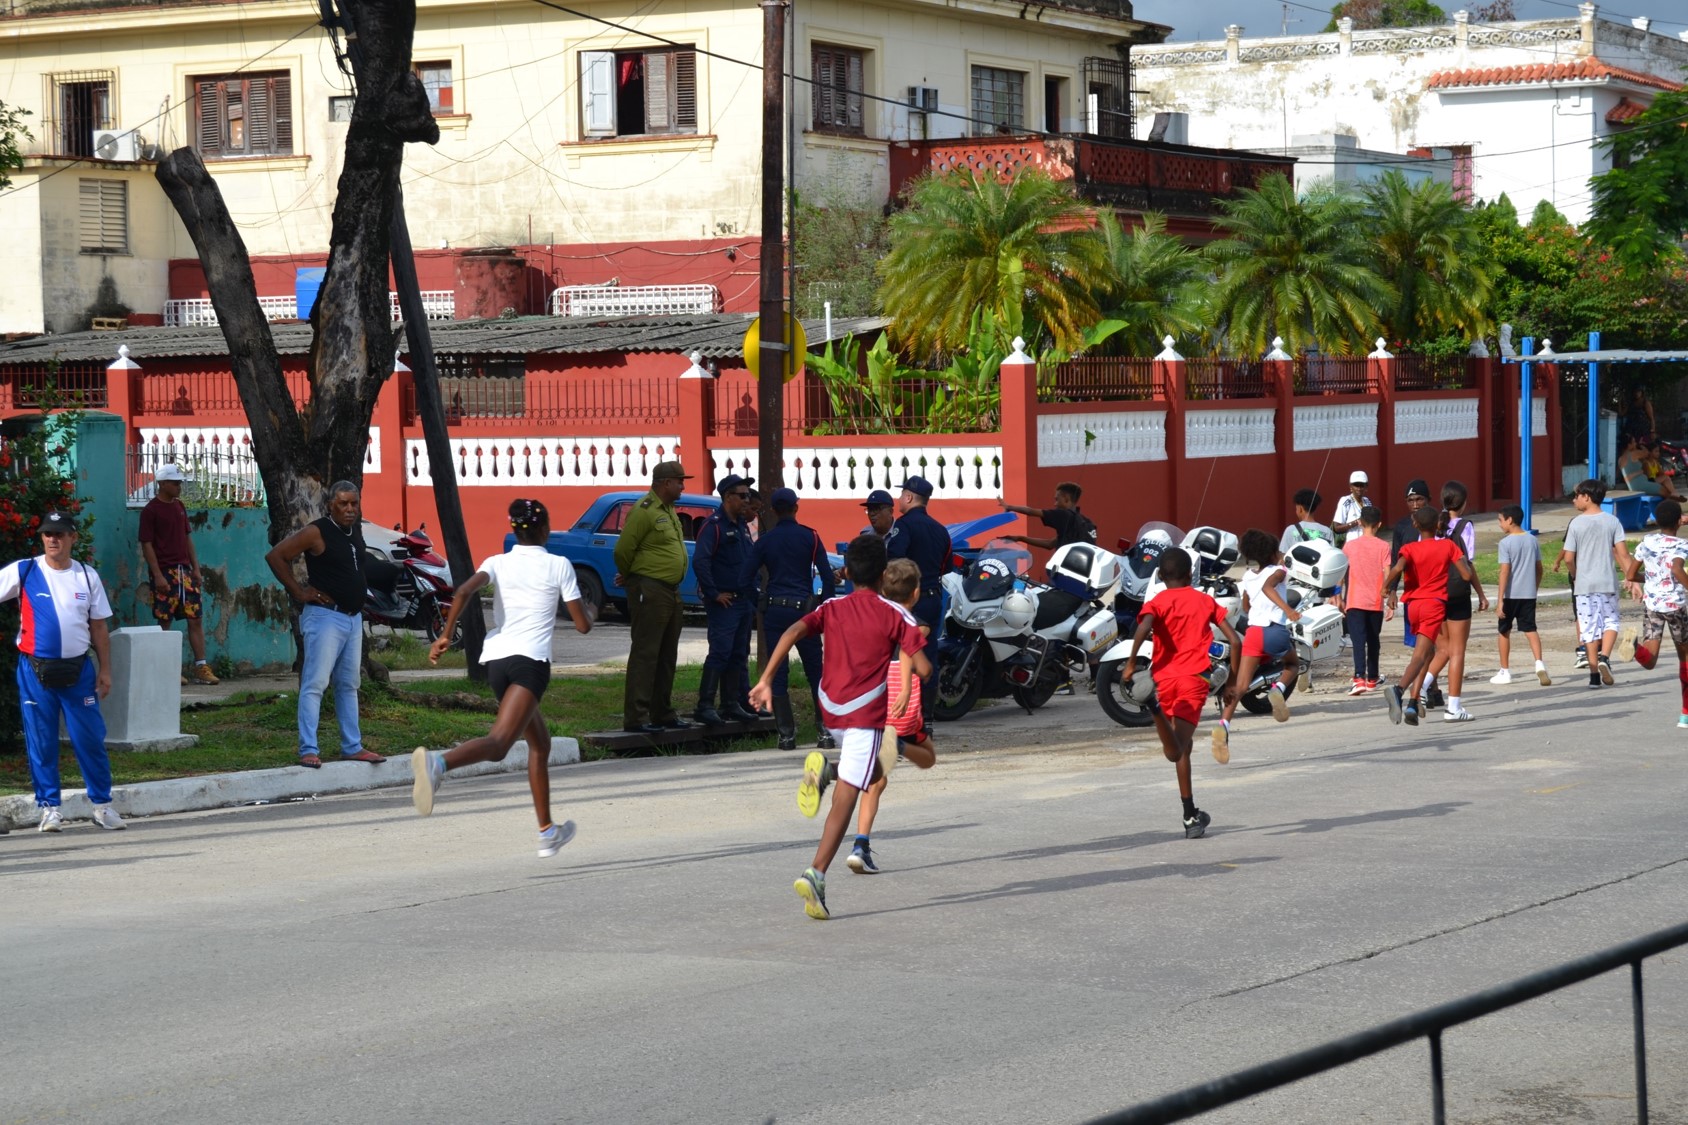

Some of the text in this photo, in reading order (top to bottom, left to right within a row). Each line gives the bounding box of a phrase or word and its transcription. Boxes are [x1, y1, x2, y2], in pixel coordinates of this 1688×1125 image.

[1139, 539, 1168, 551] POLICI
[1143, 548, 1159, 557] 002
[1315, 621, 1340, 637] POLICIA
[1320, 634, 1331, 645] 411
